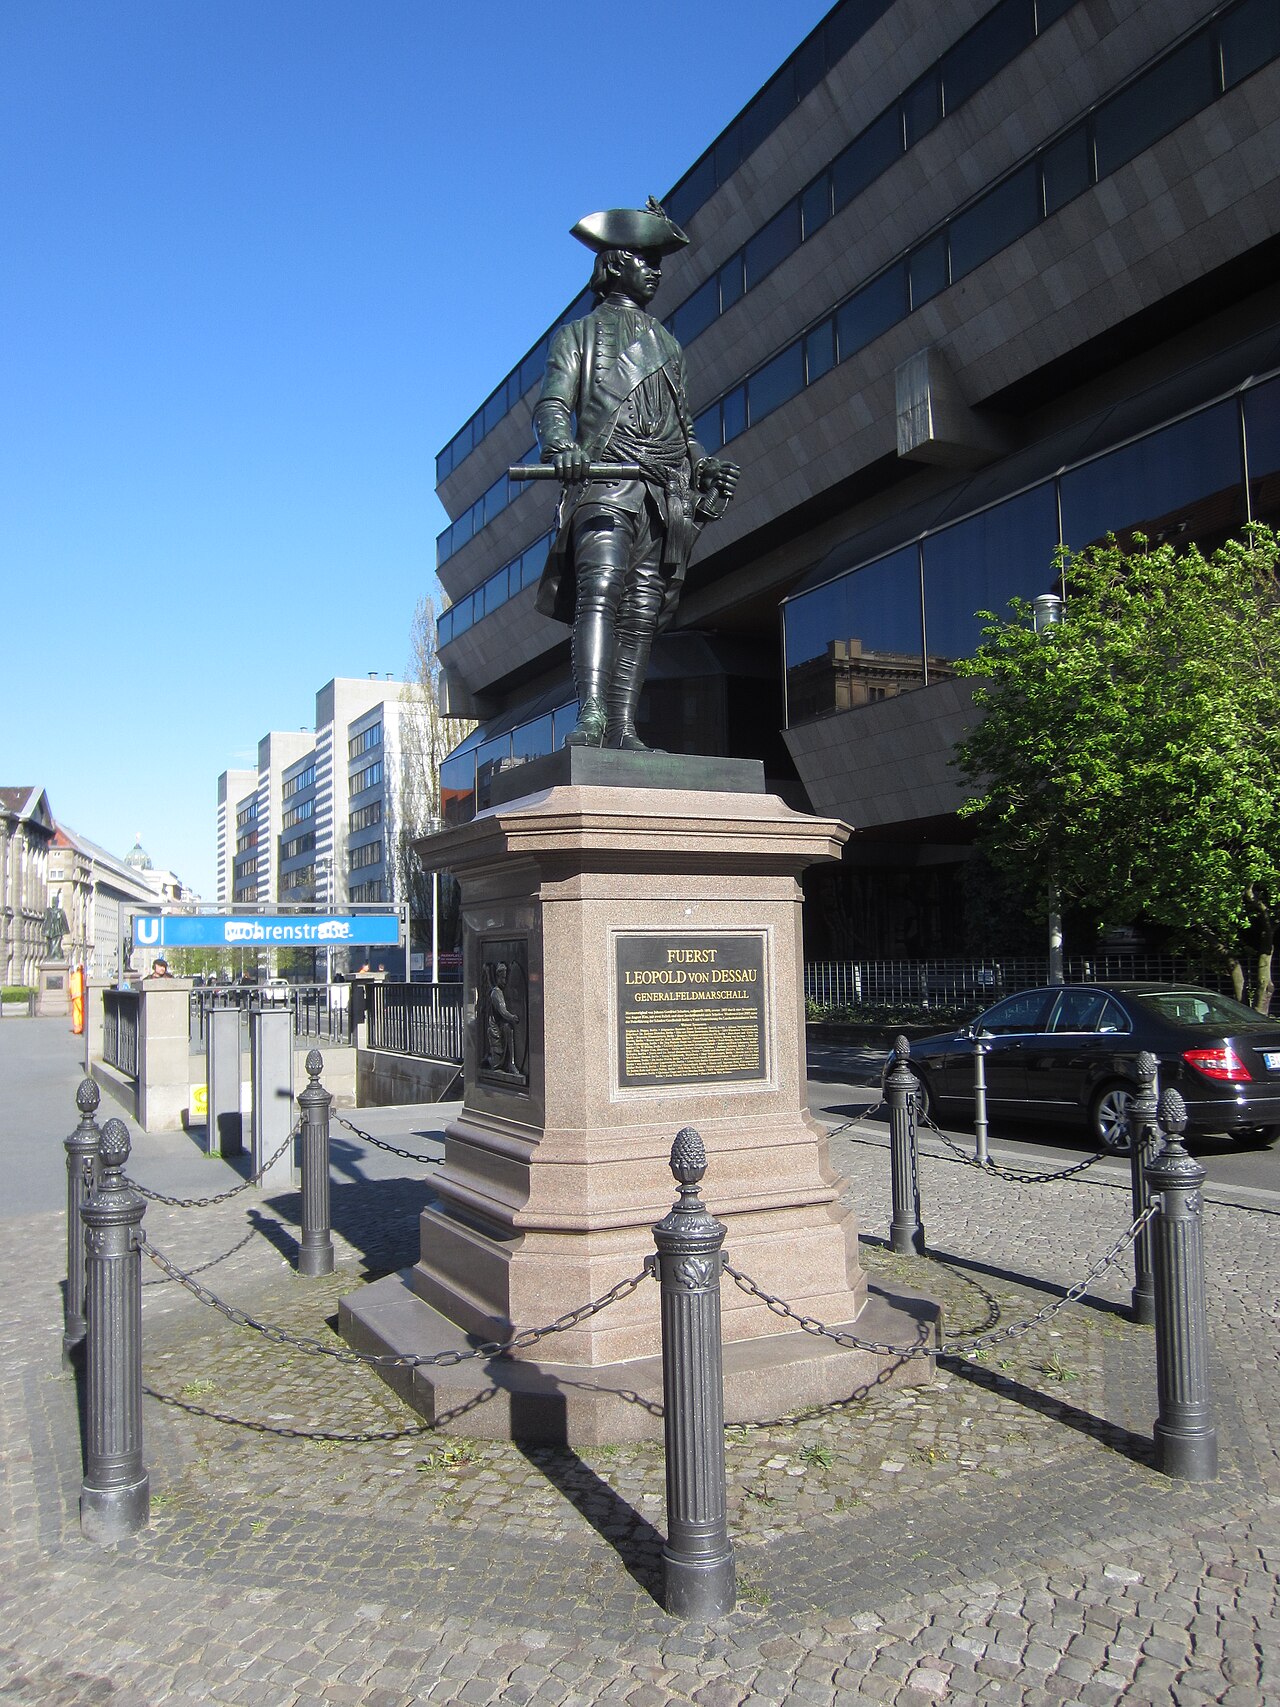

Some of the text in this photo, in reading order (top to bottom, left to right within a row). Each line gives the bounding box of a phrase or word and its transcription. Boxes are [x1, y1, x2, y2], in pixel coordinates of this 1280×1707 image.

[138, 919, 158, 944] U
[667, 949, 717, 963] FUERST
[625, 969, 757, 985] LEOPOLD VON DESSAU
[634, 990, 749, 1002] GENERALFELDMARSCHALL
